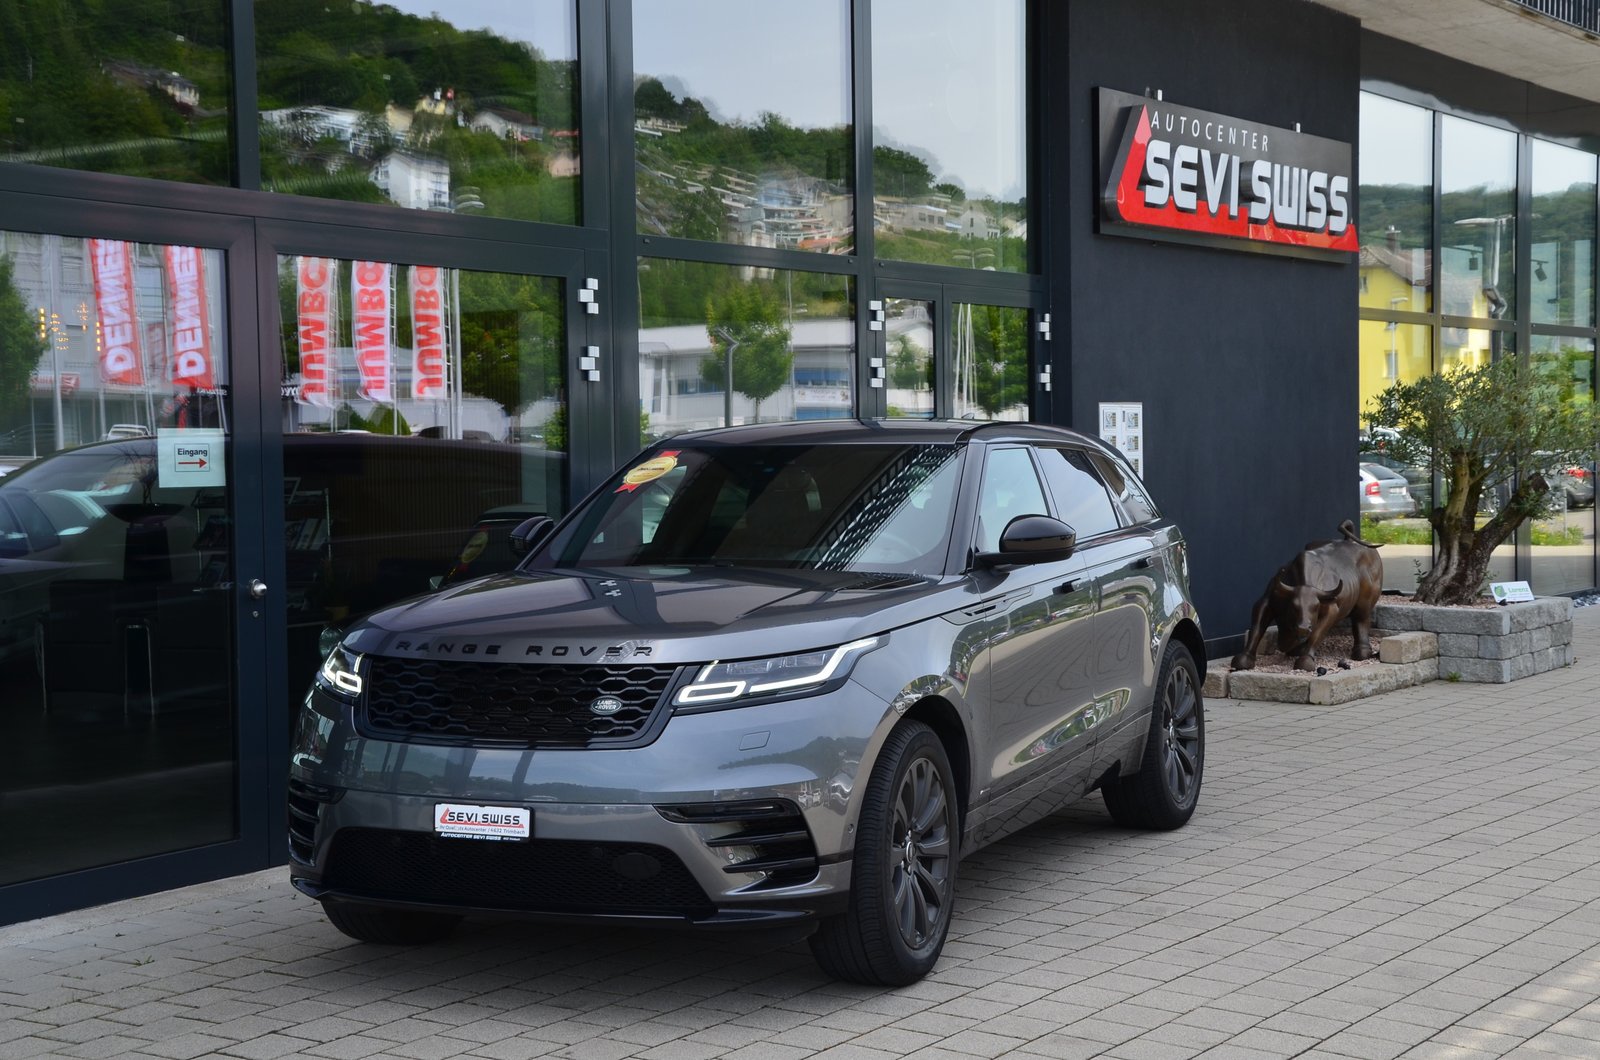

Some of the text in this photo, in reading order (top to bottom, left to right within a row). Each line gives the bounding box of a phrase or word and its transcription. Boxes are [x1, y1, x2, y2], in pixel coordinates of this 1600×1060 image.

[1150, 110, 1269, 152] AUTOCENTER
[1144, 139, 1349, 233] SEVI SWISS
[177, 447, 208, 457] Eingang
[395, 641, 653, 657] RANGE ROVER
[447, 811, 520, 825] SEVI SWISS
